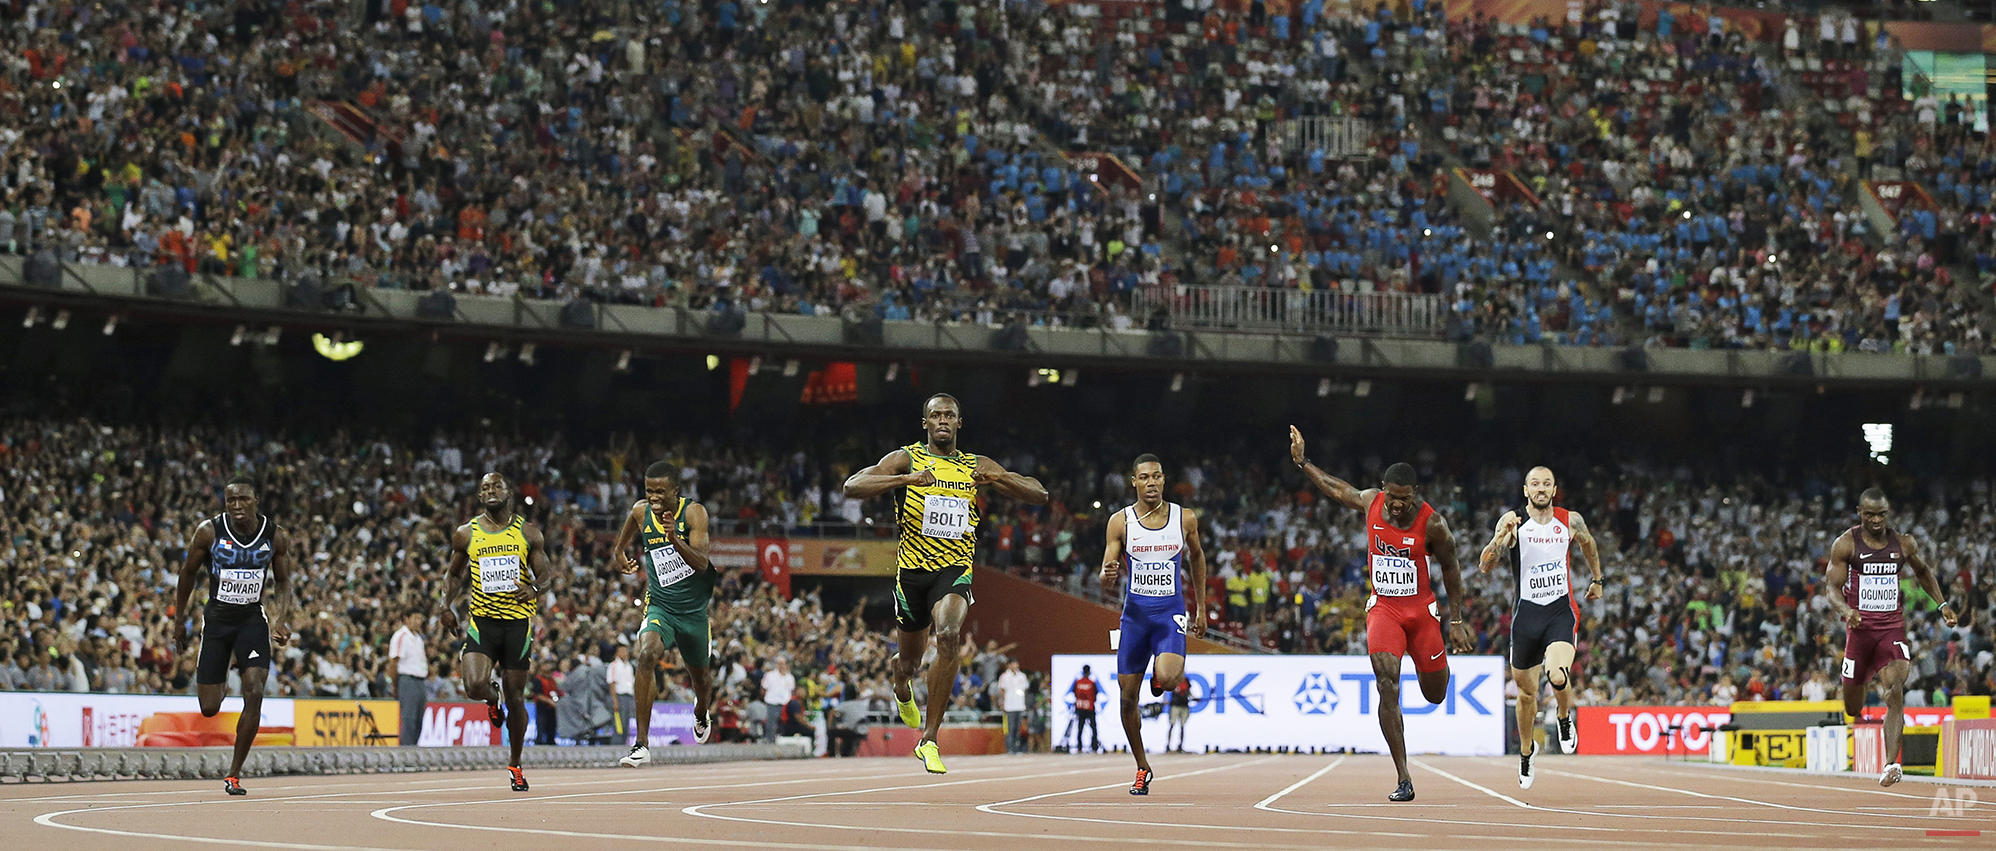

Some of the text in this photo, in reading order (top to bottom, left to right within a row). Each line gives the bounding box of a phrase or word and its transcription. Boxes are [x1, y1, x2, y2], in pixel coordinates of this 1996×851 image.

[934, 479, 972, 491] MAICA
[939, 498, 966, 509] TDK
[929, 511, 964, 527] BOLT
[924, 528, 951, 538] BEIJING
[476, 544, 520, 557] JAMAICA
[1132, 544, 1179, 553] GREAT BRITAIN
[490, 557, 516, 566] TDK
[1143, 561, 1170, 570] TDK
[1384, 557, 1412, 569] TDK
[1538, 561, 1563, 573] TDK
[1863, 563, 1898, 574] QATAR
[234, 571, 260, 580] TDK
[481, 569, 518, 583] ASHMEADE
[661, 573, 684, 586] BEIJING
[1134, 573, 1172, 586] HUGHES
[1375, 570, 1414, 585] GATLIN
[1529, 573, 1566, 590] GULIYEV
[1872, 577, 1895, 585] TDK
[221, 581, 260, 594] EDWARD
[1376, 587, 1415, 595] BEIJING 2015
[1531, 590, 1555, 599] BEIJING
[1861, 588, 1897, 600] OGUNODE
